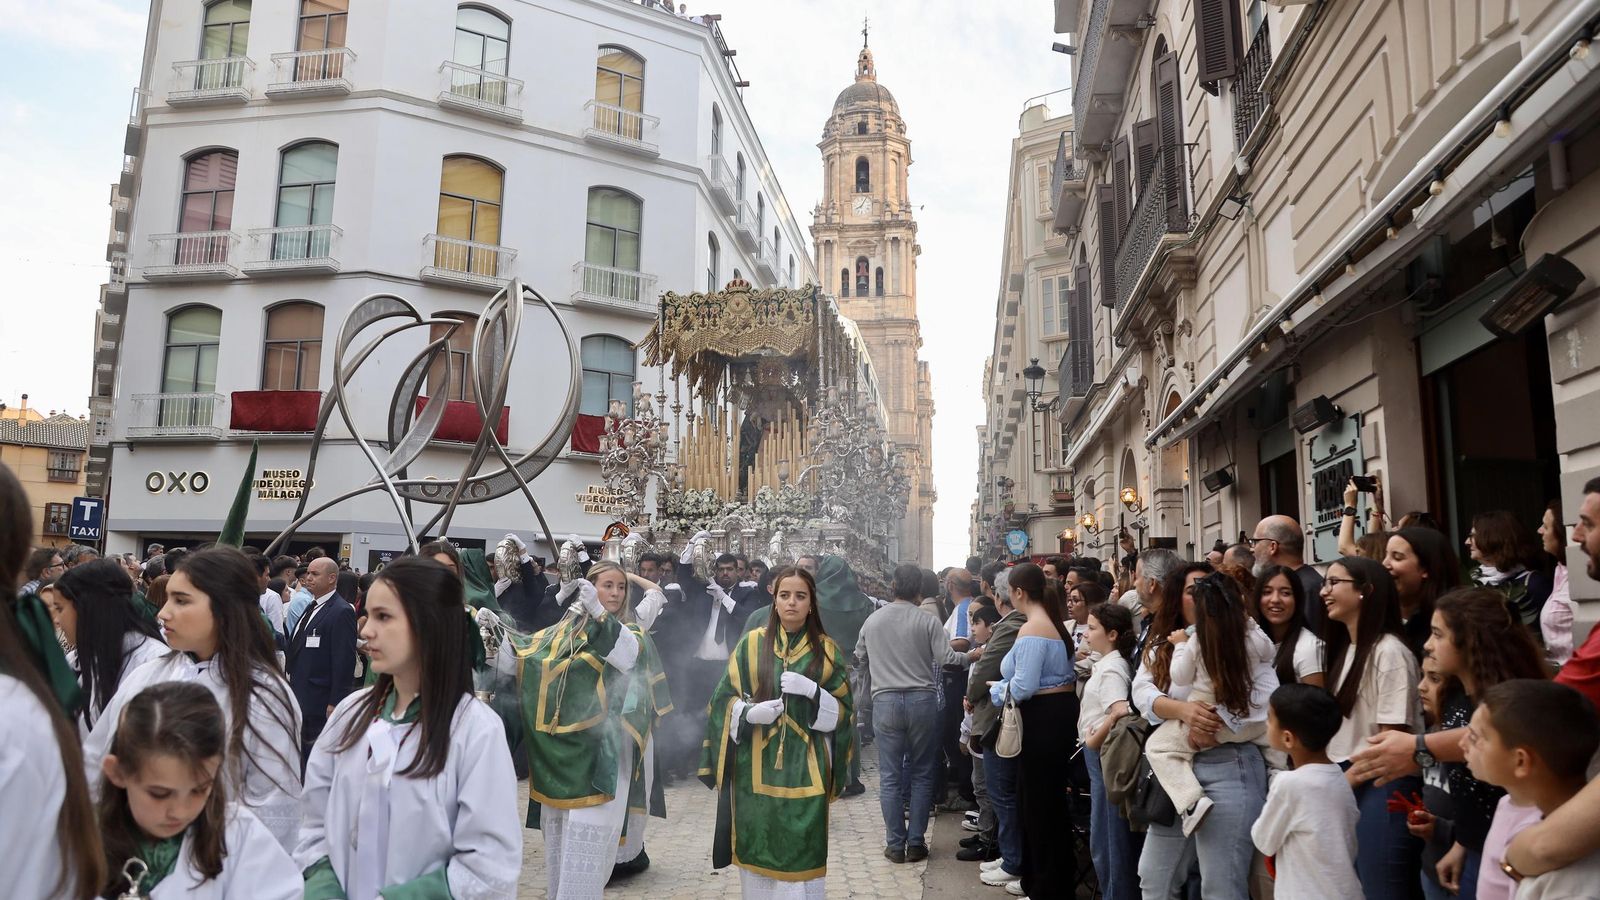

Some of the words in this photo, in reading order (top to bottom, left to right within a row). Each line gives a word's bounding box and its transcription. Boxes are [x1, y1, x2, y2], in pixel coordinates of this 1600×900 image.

[262, 469, 301, 479] MUSEO
[145, 471, 209, 493] OXO
[257, 487, 303, 499] MÁLAGA
[79, 501, 98, 521] T
[71, 526, 100, 537] TAXI
